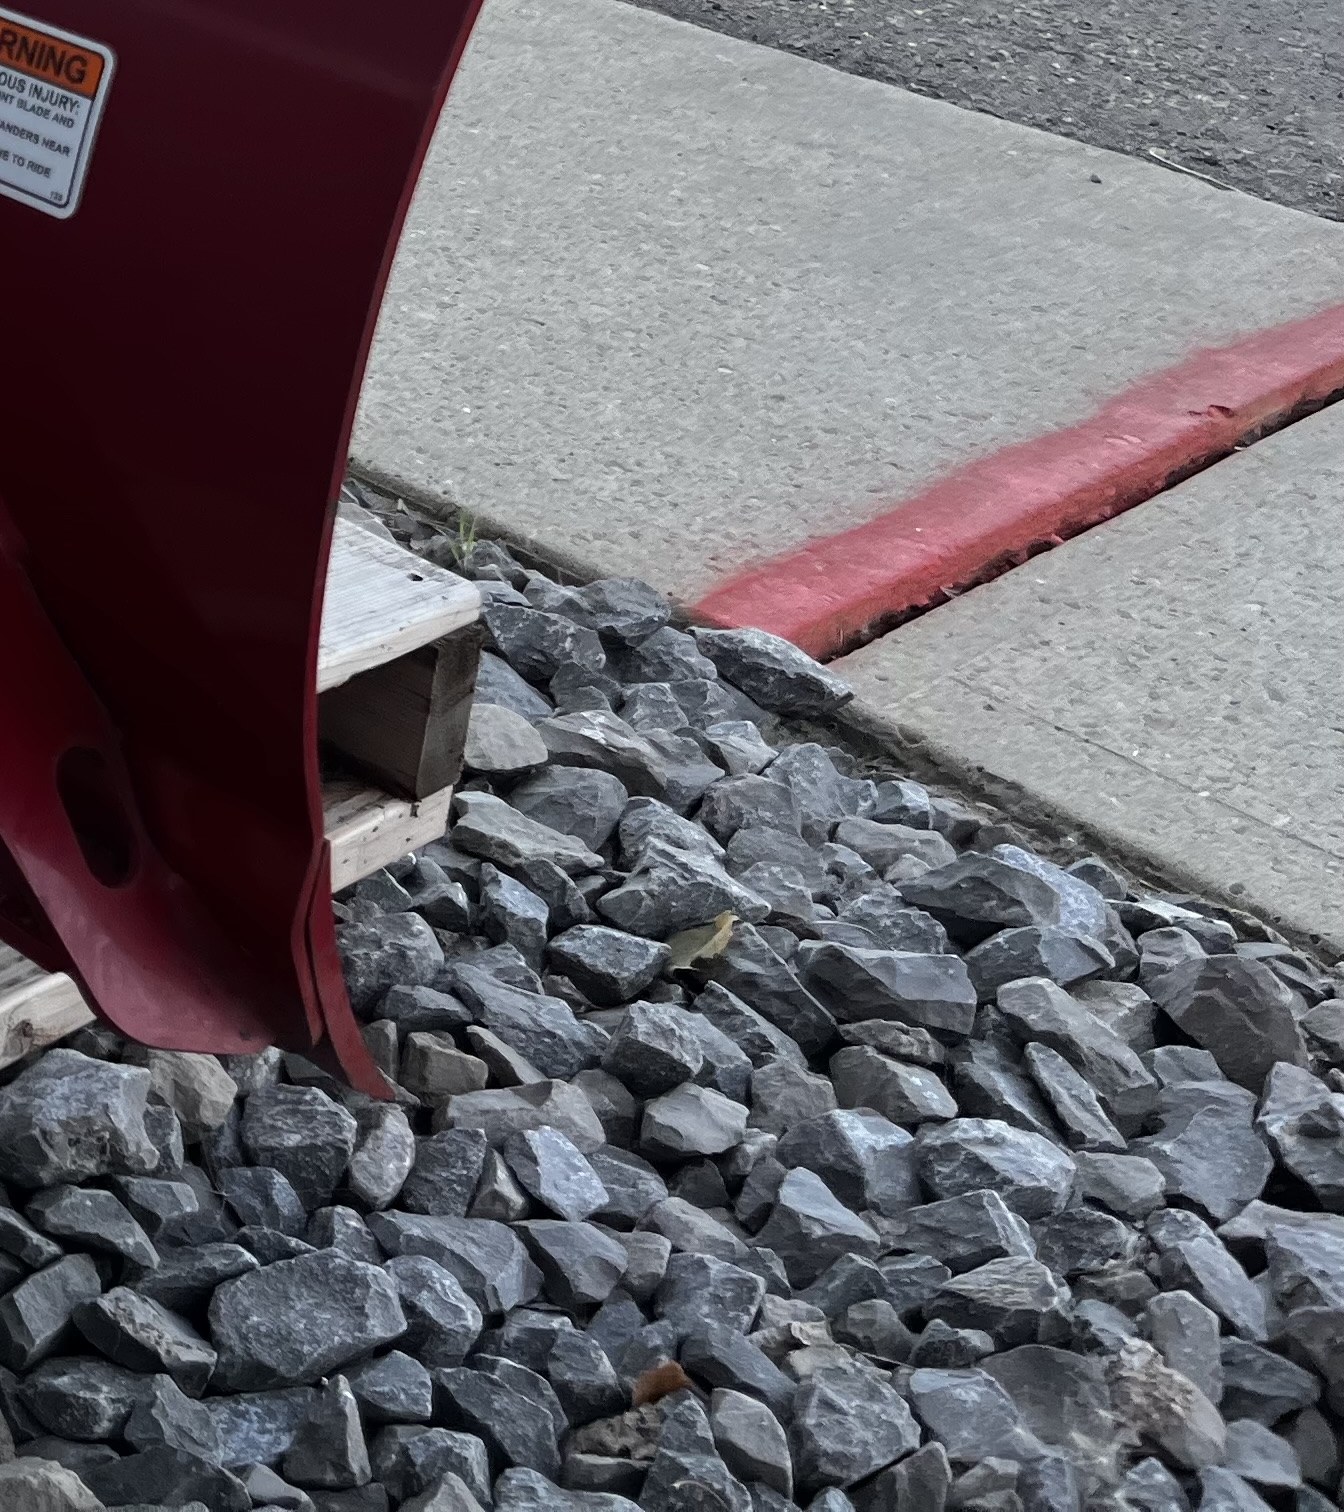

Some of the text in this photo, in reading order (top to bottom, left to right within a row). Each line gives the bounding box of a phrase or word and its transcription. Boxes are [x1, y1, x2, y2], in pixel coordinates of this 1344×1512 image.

[29, 84, 82, 116] INJURY:
[17, 99, 51, 119] BLADE
[53, 113, 75, 129] AND
[42, 138, 71, 156] NEAR
[12, 154, 25, 168] TO
[28, 161, 51, 178] RIDE
